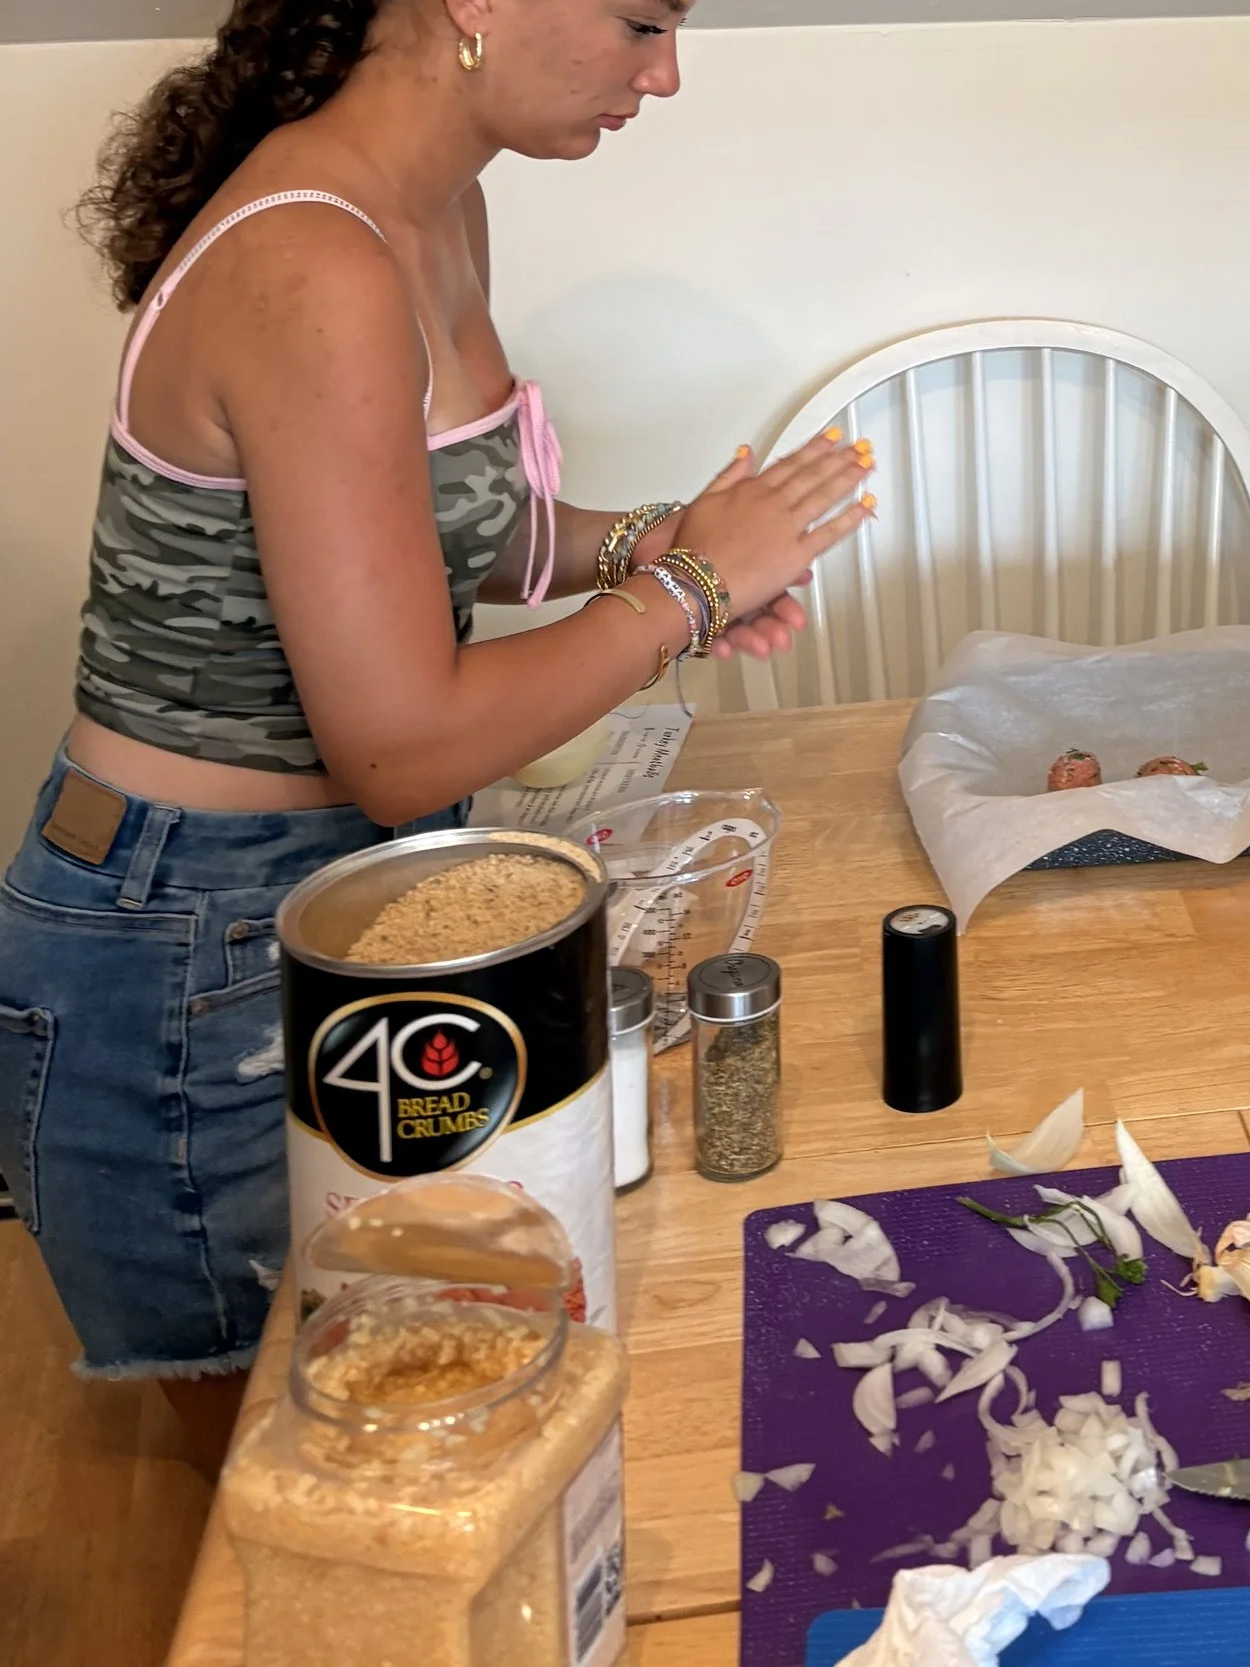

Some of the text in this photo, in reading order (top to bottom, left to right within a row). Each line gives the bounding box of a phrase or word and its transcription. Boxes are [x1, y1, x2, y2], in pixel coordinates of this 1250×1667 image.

[322, 1013, 483, 1163] 4C
[396, 1091, 471, 1118] BREAD
[396, 1107, 490, 1140] CRUMBS
